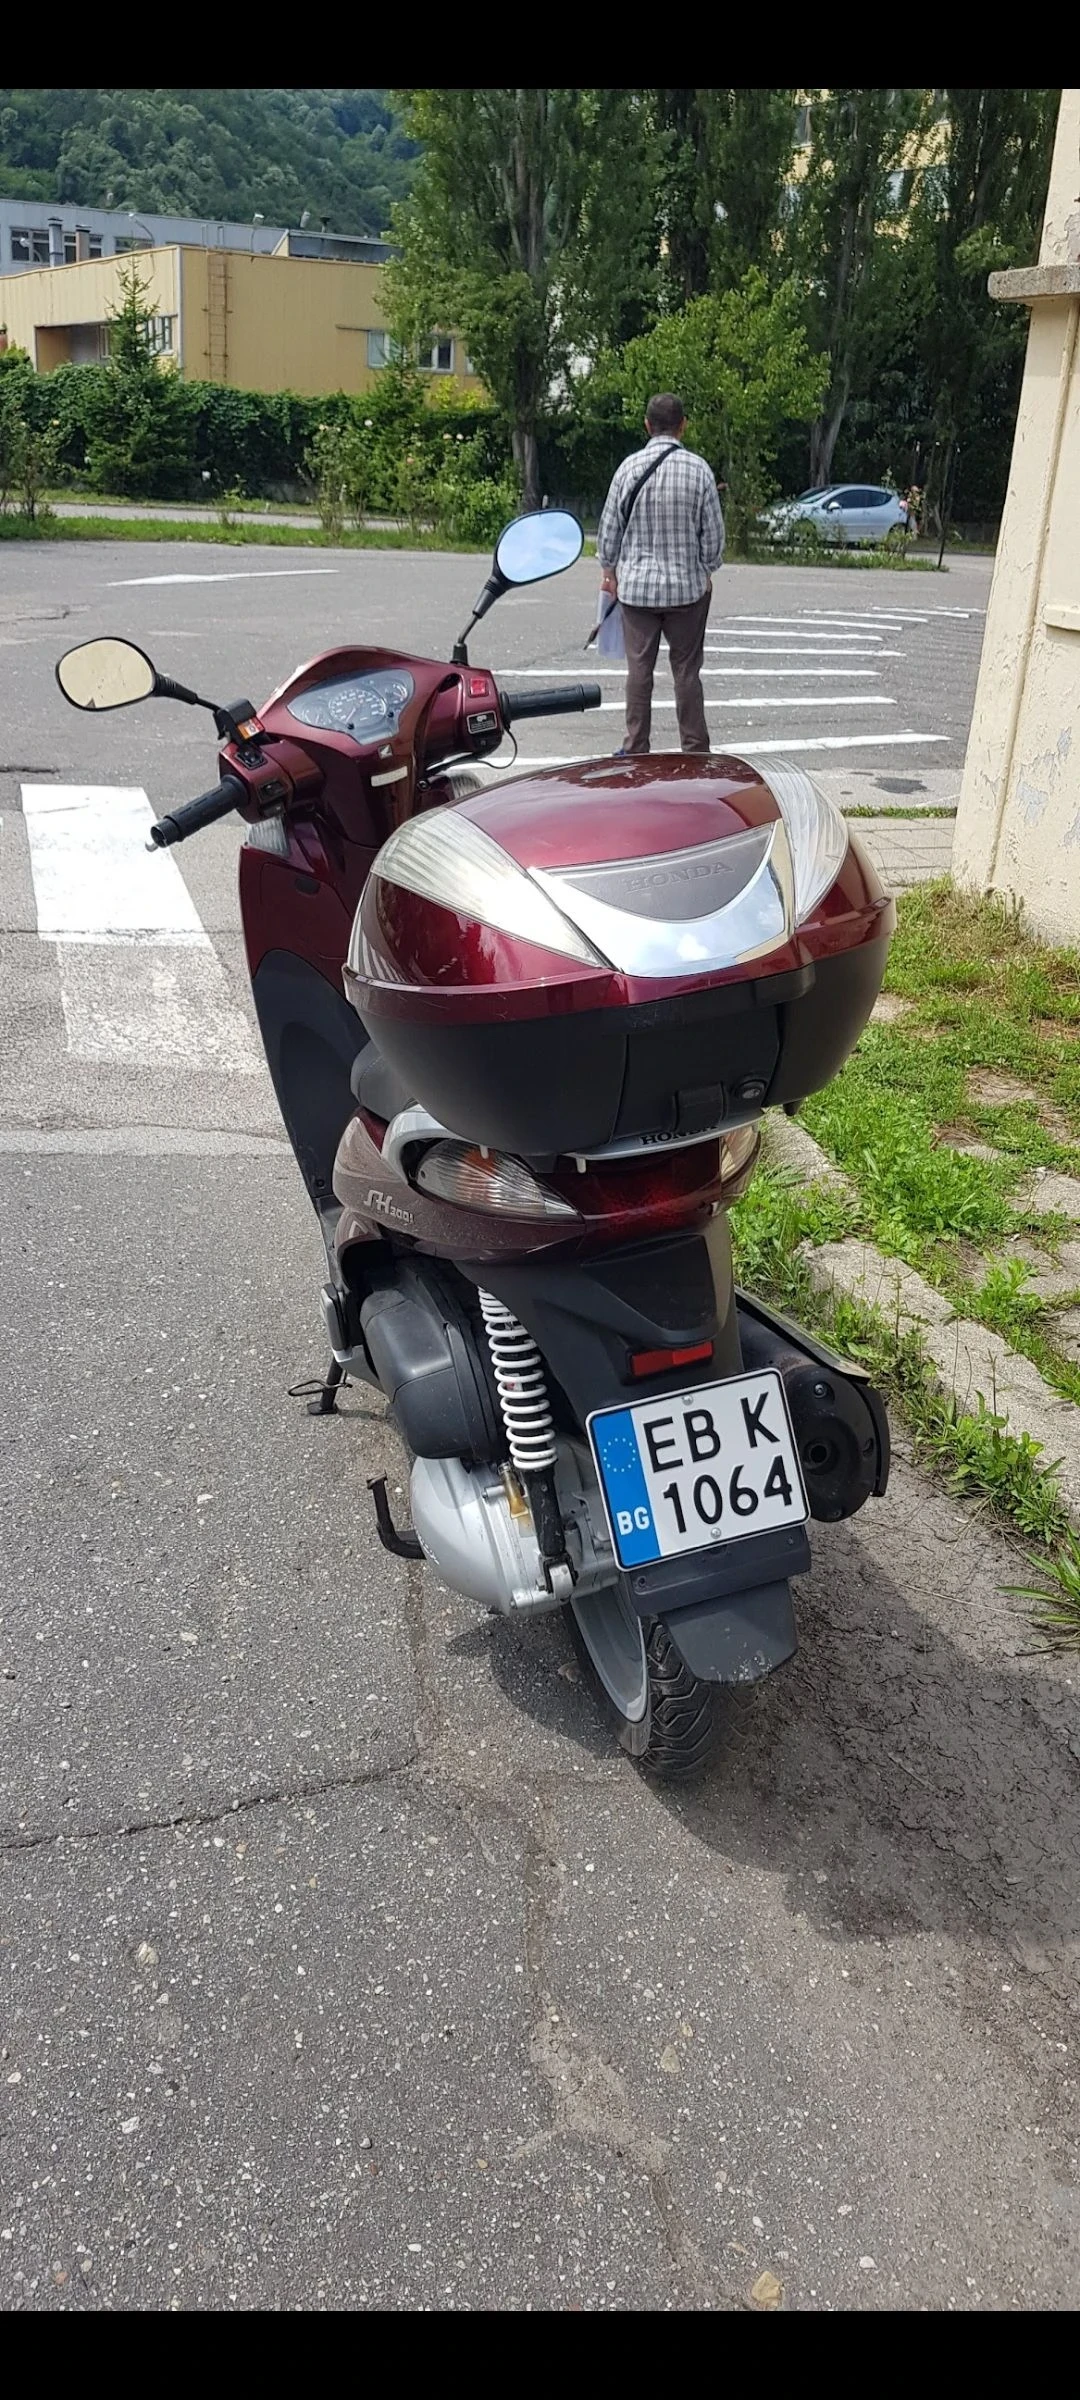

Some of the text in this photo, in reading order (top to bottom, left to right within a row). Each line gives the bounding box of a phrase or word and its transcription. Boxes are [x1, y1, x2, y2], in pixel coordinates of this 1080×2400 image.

[621, 860, 734, 893] HONDA
[641, 1125, 718, 1145] HON
[643, 1391, 780, 1473] EB K
[663, 1454, 793, 1533] 1064
[616, 1506, 650, 1535] BG
